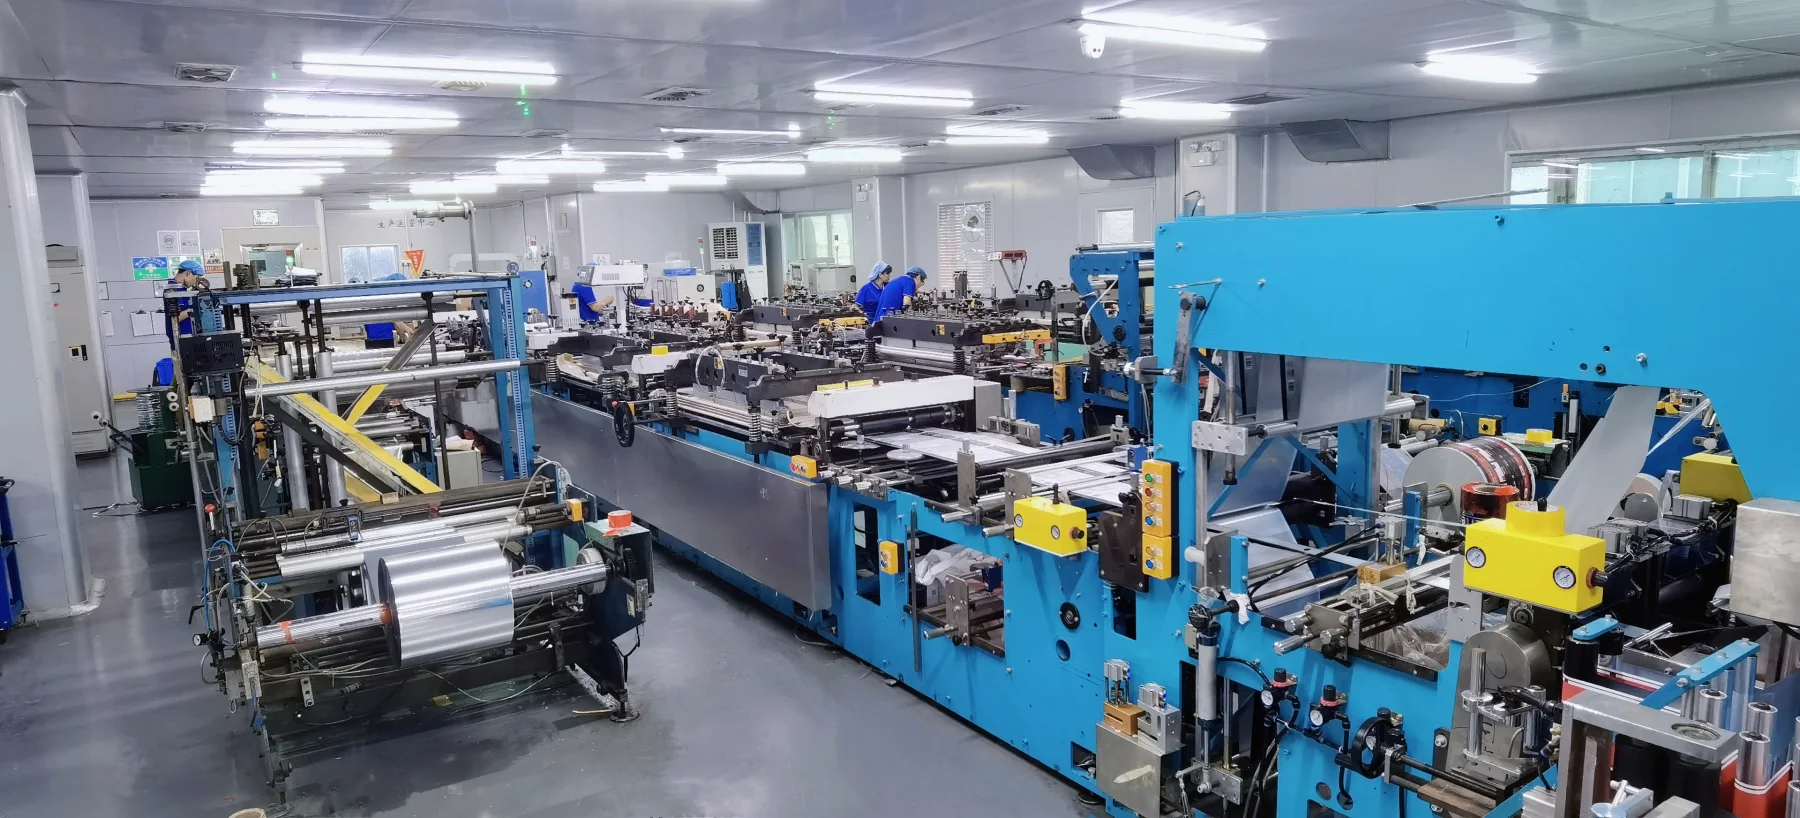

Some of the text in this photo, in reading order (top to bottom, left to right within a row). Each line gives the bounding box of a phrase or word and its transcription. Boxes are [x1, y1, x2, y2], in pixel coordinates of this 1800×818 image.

[377, 218, 437, 229] 生产运营中心
